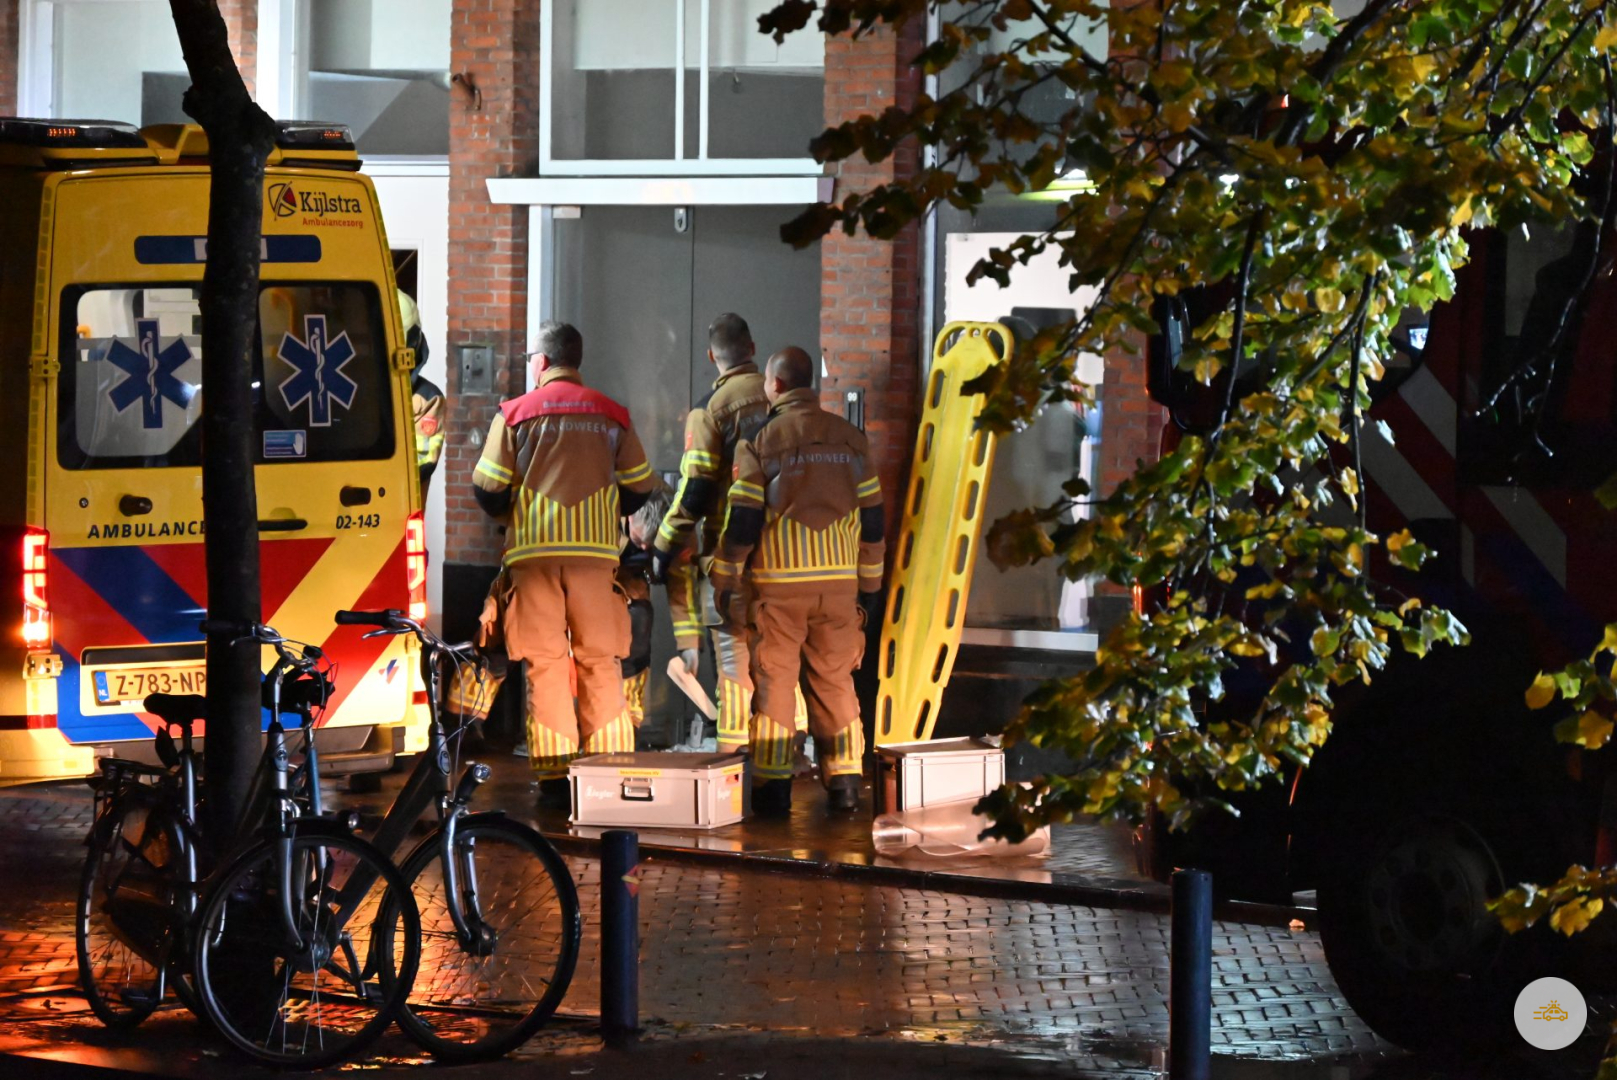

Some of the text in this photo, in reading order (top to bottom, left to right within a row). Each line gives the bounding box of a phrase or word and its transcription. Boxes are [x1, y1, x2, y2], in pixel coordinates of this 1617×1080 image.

[299, 192, 362, 217] Kijlstra
[302, 217, 364, 229] Ambulancezorg
[87, 520, 206, 538] AMBULANCE
[336, 513, 380, 529] 02-143
[115, 671, 206, 697] Z-783-NP
